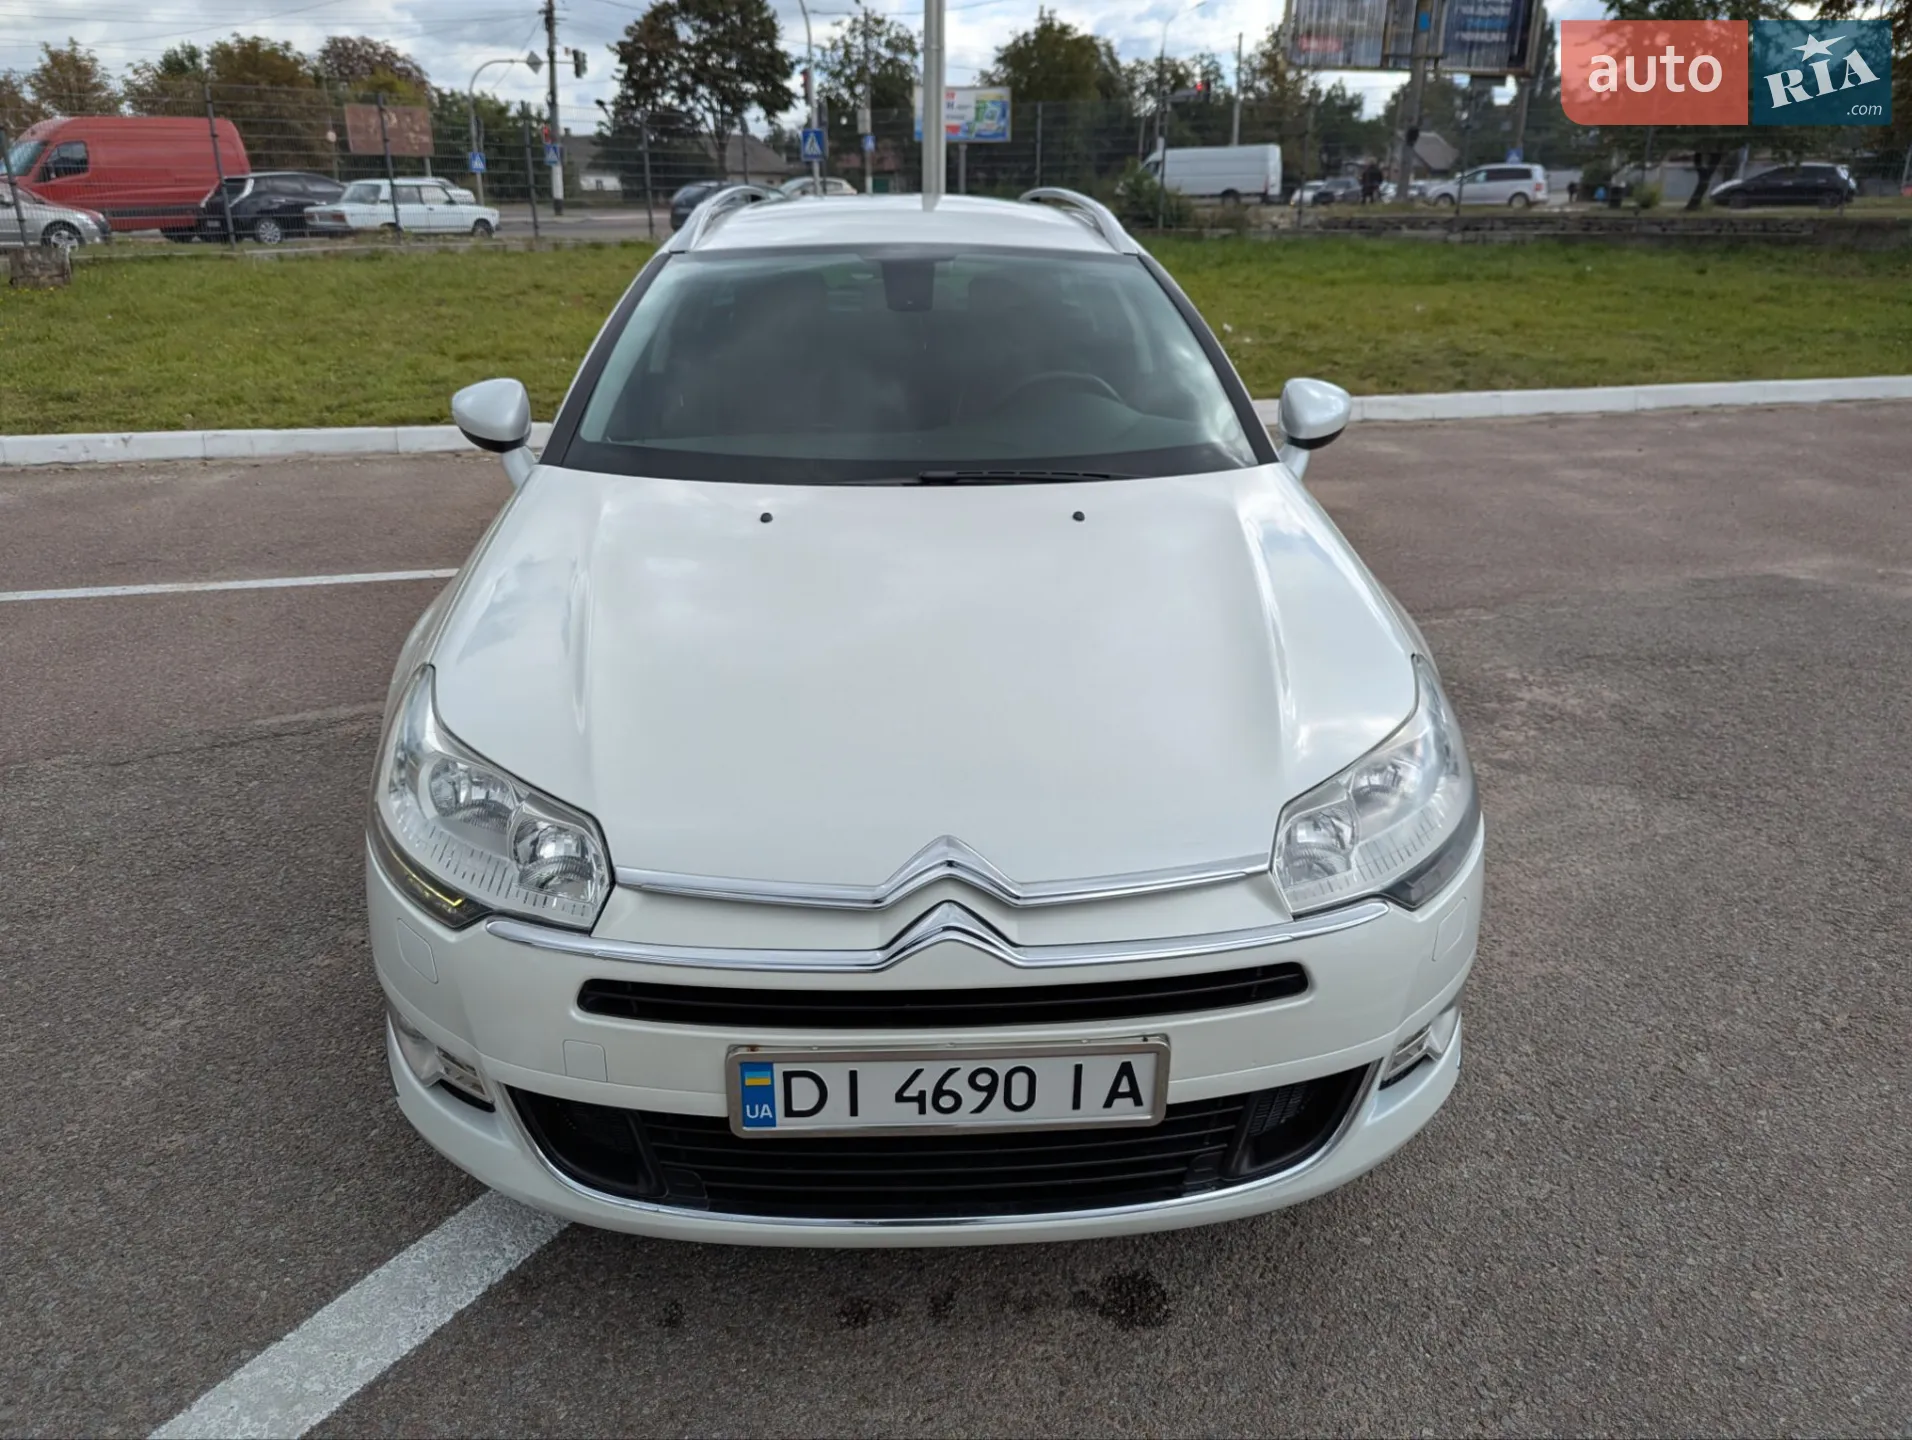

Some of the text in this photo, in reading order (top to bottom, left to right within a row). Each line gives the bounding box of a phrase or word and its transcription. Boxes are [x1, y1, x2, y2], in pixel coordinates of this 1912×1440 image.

[782, 1060, 1144, 1119] DI 4690 IA
[745, 1103, 774, 1119] UA
